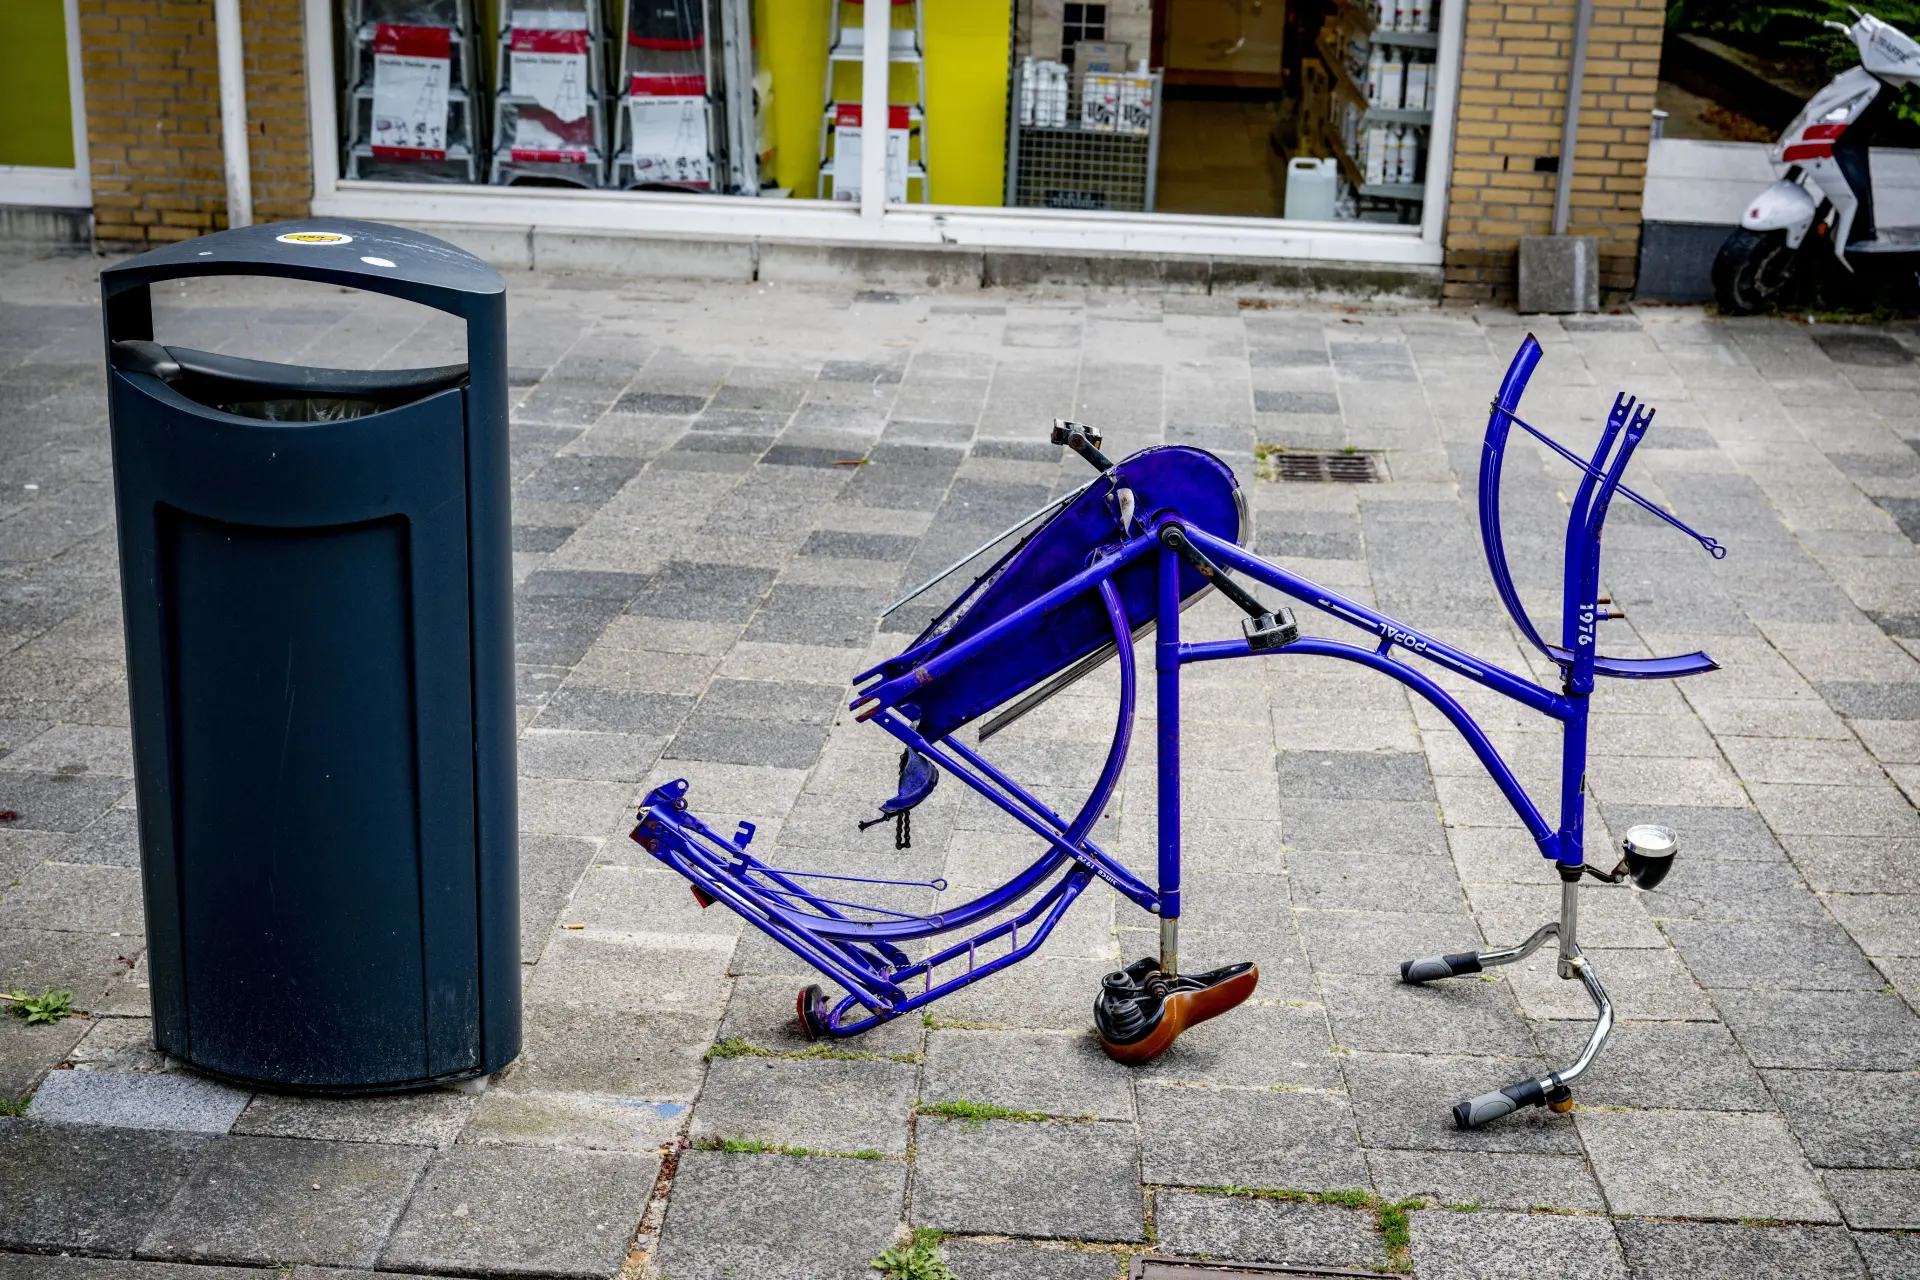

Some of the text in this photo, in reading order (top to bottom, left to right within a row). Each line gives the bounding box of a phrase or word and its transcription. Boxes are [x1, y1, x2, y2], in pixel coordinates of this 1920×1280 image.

[1378, 622, 1427, 652] POPAL
[1577, 603, 1595, 646] 1976
[1076, 855, 1118, 886] SINCE 1976
